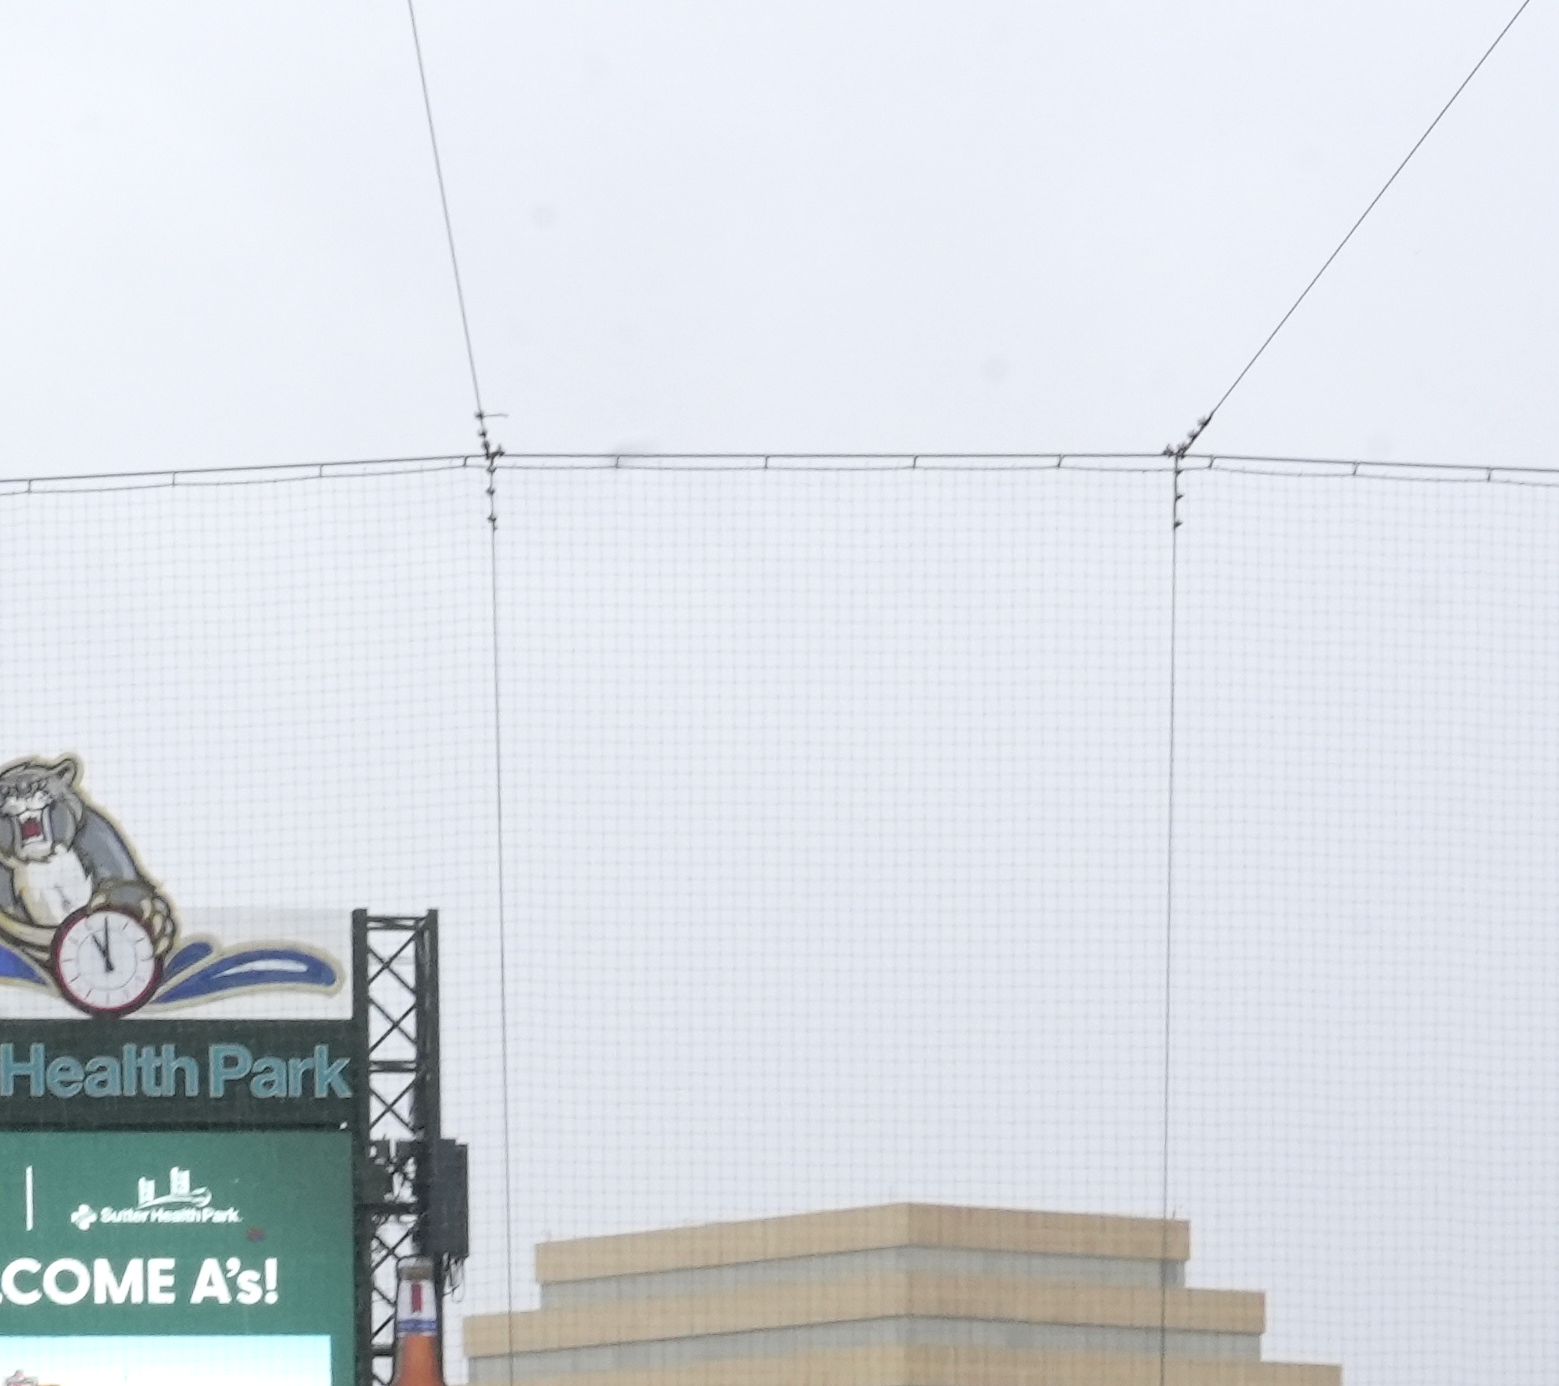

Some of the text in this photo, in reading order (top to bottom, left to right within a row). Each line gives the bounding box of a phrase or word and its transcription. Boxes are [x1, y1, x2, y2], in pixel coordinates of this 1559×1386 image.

[208, 1044, 353, 1098] Park
[100, 1207, 240, 1223] Sutter Health Park
[190, 1257, 279, 1305] A's!
